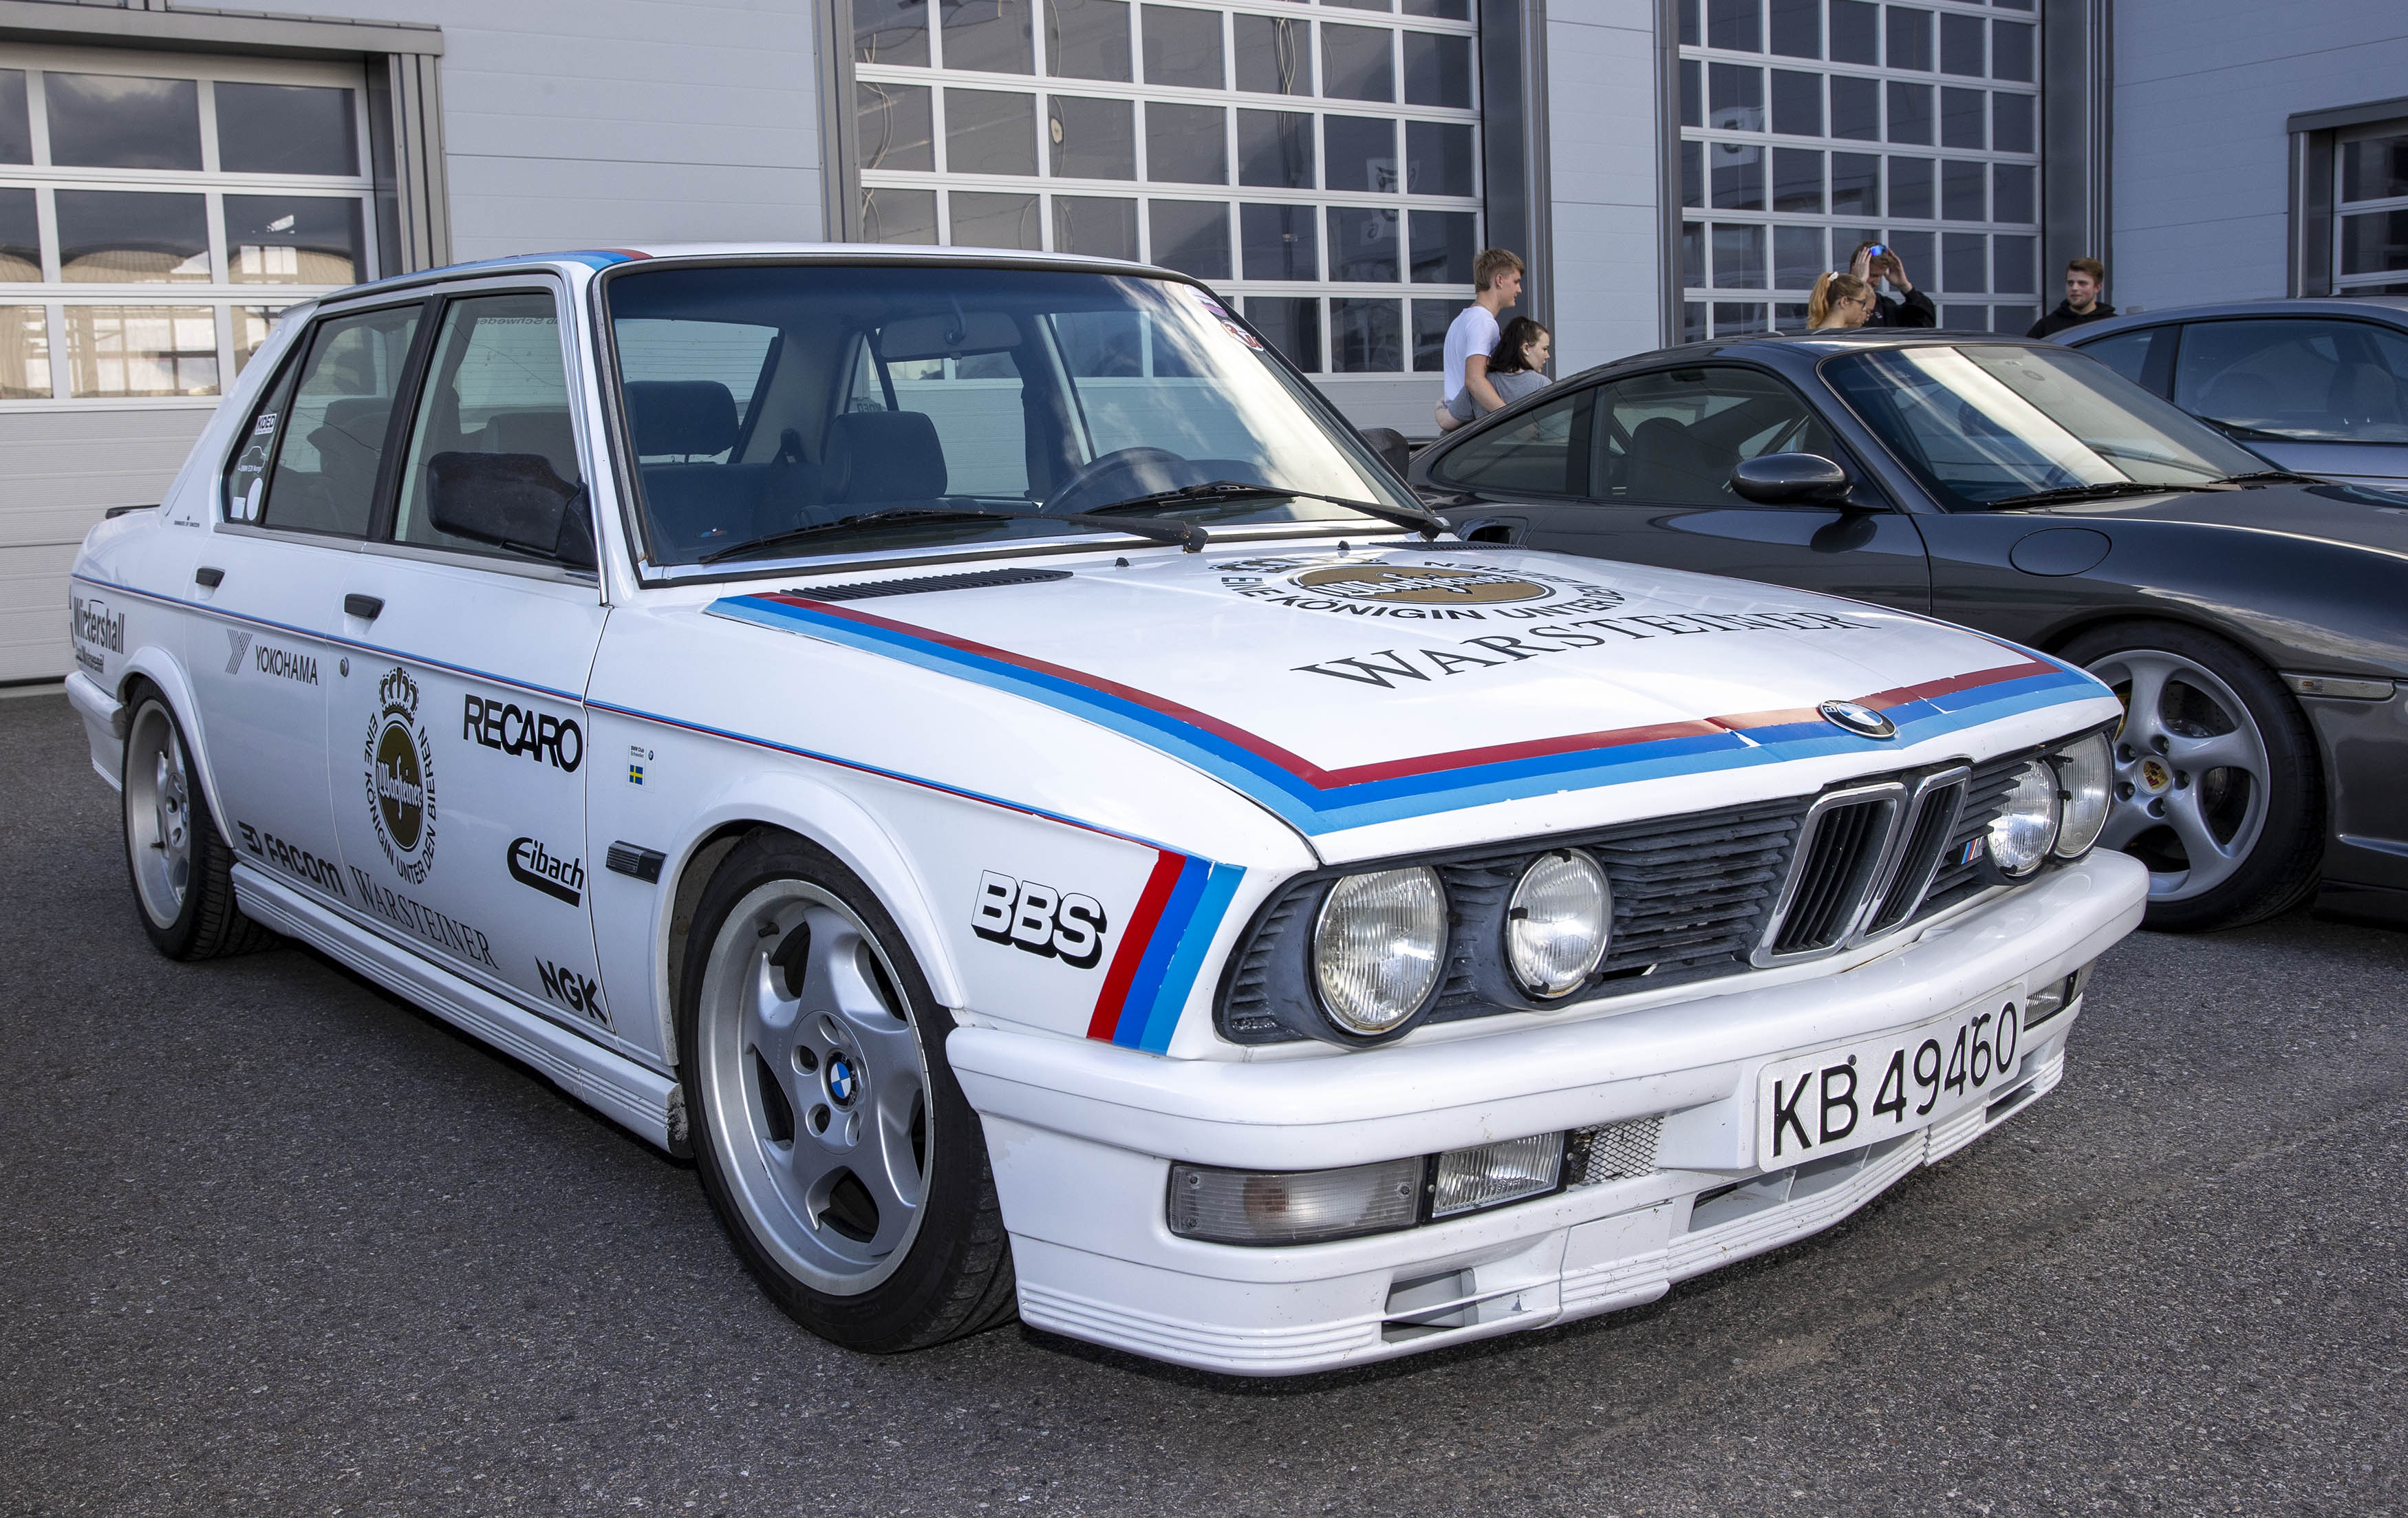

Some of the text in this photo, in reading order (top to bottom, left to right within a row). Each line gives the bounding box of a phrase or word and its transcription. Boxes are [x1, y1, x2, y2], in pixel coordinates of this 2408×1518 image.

[1221, 577, 1285, 597] EINE
[1265, 595, 1486, 619] KÖNIGIN
[1492, 598, 1623, 619] UNTER
[255, 645, 318, 685] YOKOHAMA
[1289, 612, 1881, 689] WARSTEINER
[463, 694, 583, 773] RECARO
[365, 712, 437, 886] EINE KÖNIGIN UNTER DEN BIEREN
[506, 837, 585, 908] Eibach
[349, 864, 500, 971] WARSTEINER
[971, 869, 1108, 970] BBS
[534, 954, 608, 1026] NGK
[1772, 1001, 2018, 1157] KB 49460
